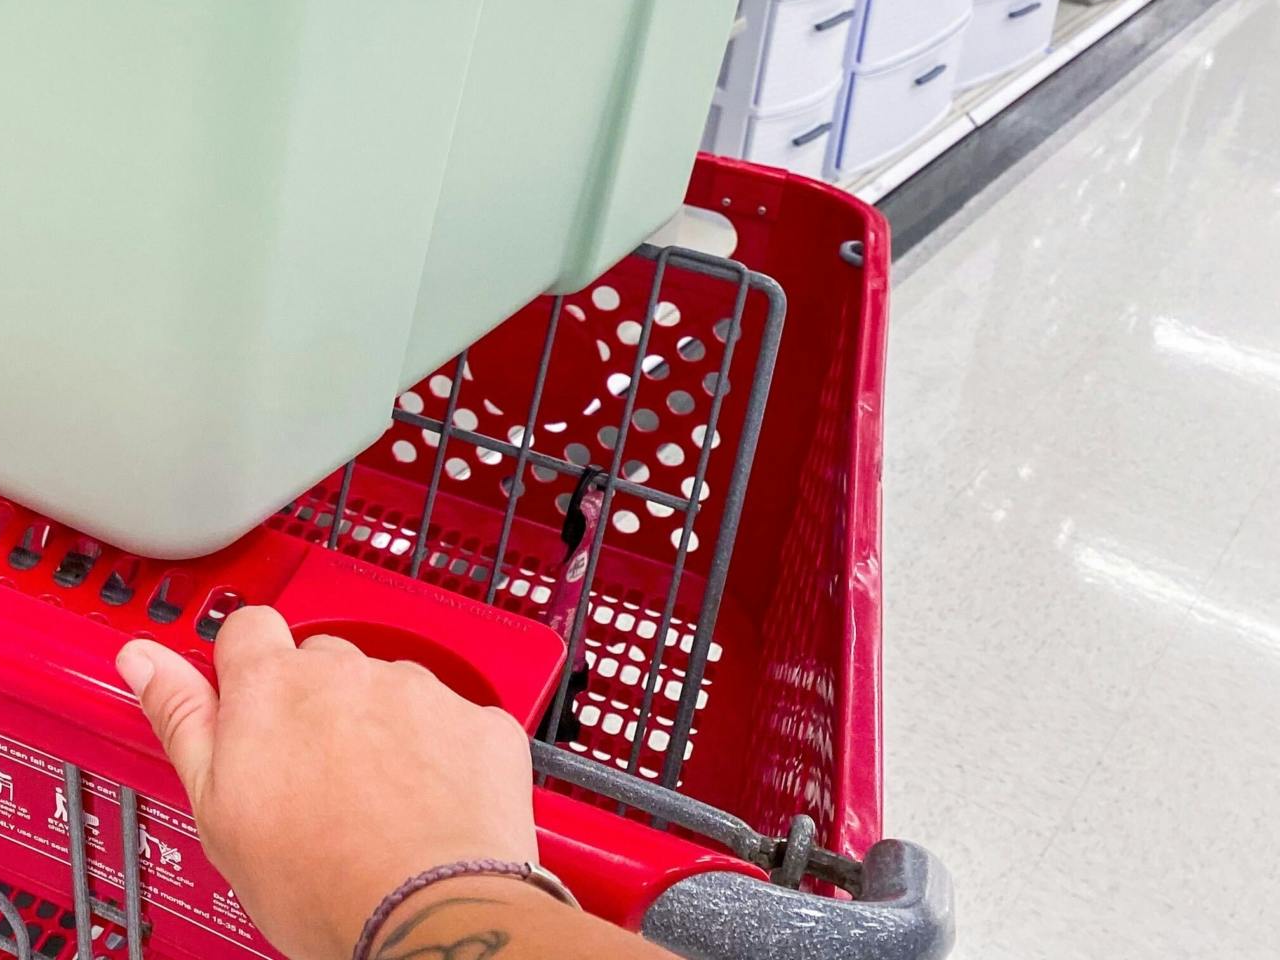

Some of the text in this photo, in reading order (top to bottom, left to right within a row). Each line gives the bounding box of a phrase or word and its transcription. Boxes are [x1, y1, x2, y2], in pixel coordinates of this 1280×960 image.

[10, 748, 28, 760] can
[30, 755, 45, 767] fall
[96, 784, 117, 798] cart
[140, 804, 171, 821] suffer
[47, 817, 69, 831] STAY
[17, 828, 32, 838] use
[33, 834, 49, 846] cart
[51, 842, 69, 854] seat
[160, 891, 192, 911] months
[193, 907, 210, 920] and
[213, 892, 240, 909] Do NO
